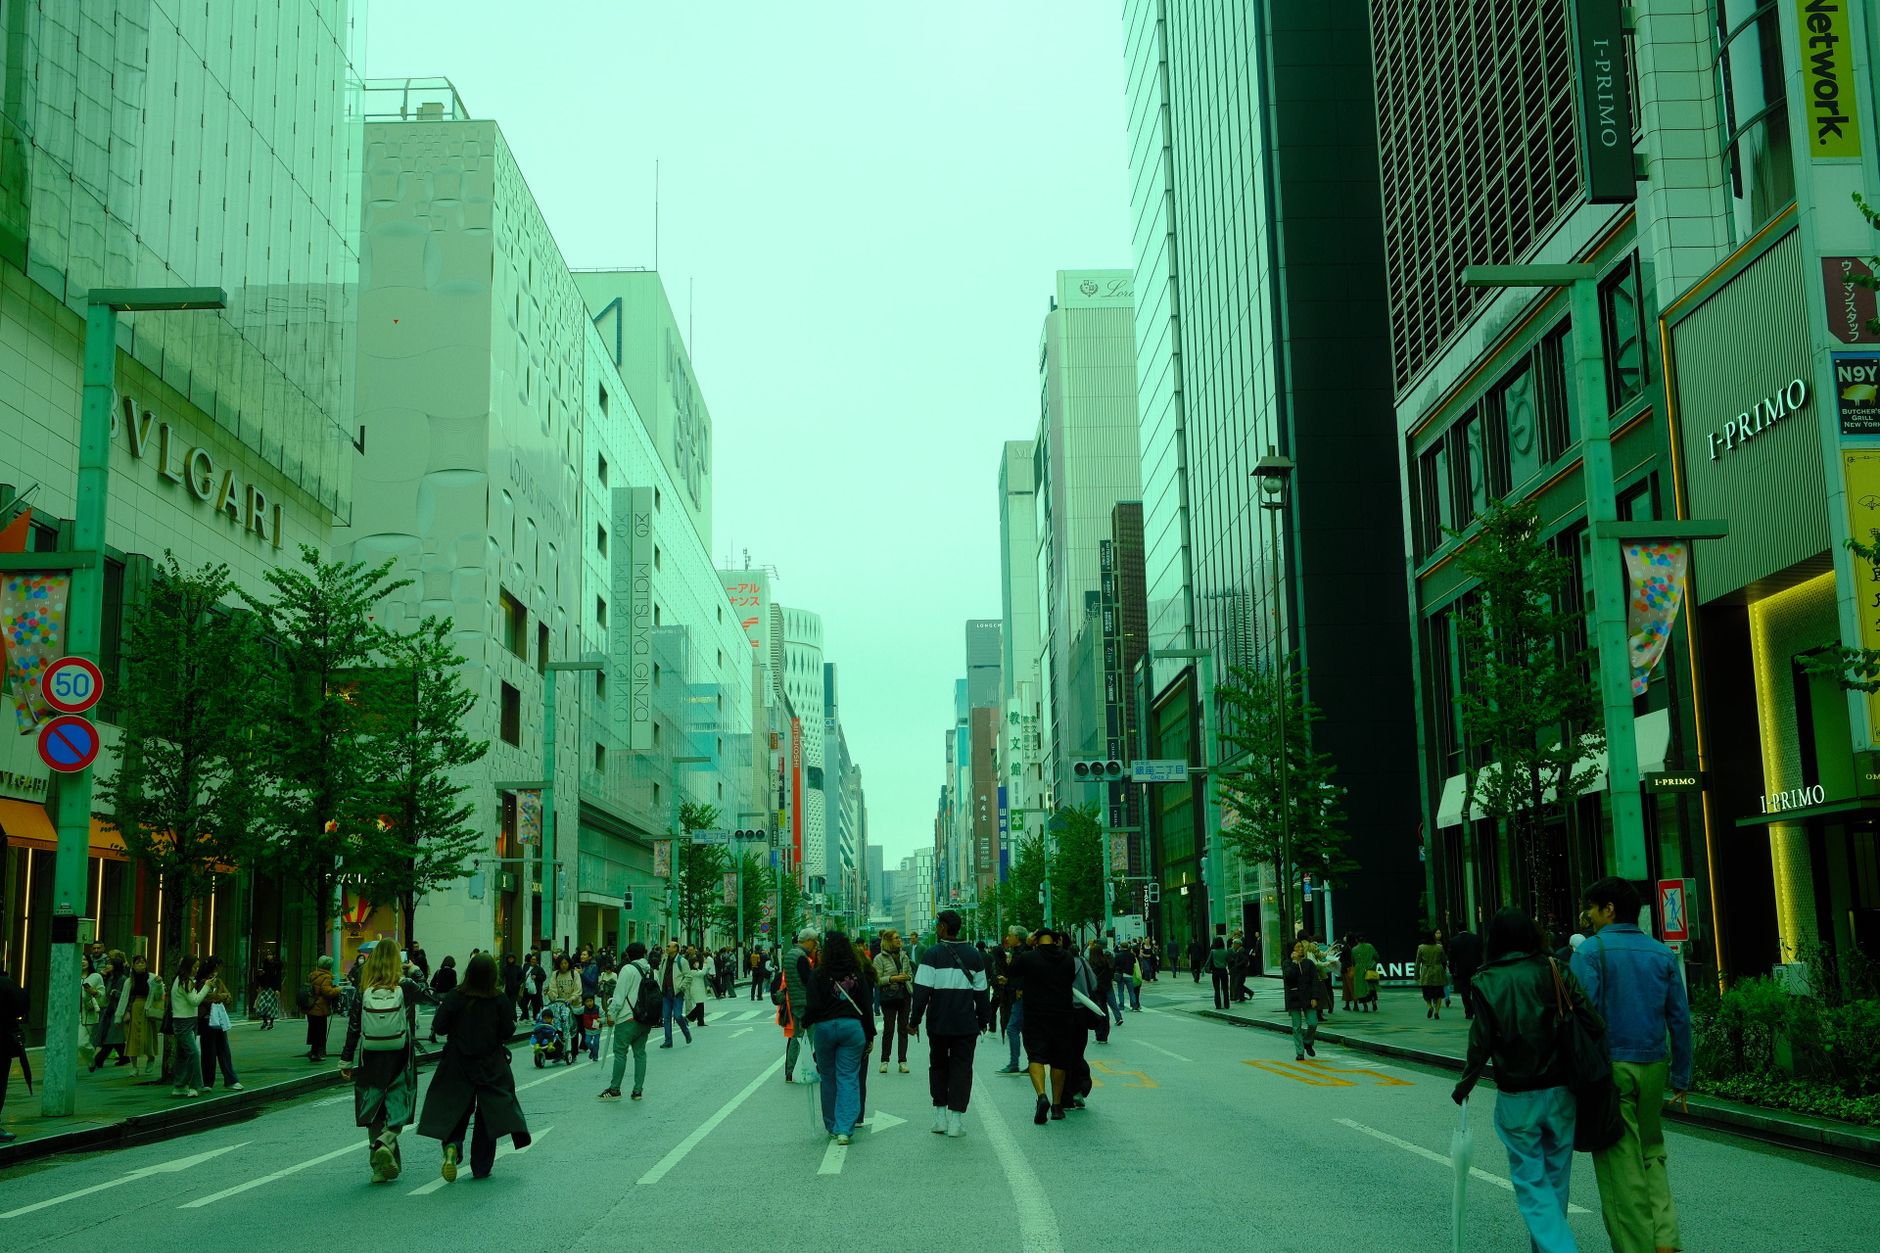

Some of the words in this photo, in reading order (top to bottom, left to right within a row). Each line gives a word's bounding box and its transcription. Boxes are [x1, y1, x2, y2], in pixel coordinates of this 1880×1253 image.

[1593, 39, 1617, 147] I-PRIMO
[1837, 366, 1878, 383] N9Y
[1707, 379, 1805, 460] I-PRIMO
[510, 451, 534, 505] LOUIS
[536, 483, 567, 541] VUITTON
[55, 672, 90, 698] 50
[1135, 765, 1184, 775] 銀座二丁目
[1655, 777, 1696, 786] I-PRIMO
[1760, 784, 1825, 814] I-PRIMO
